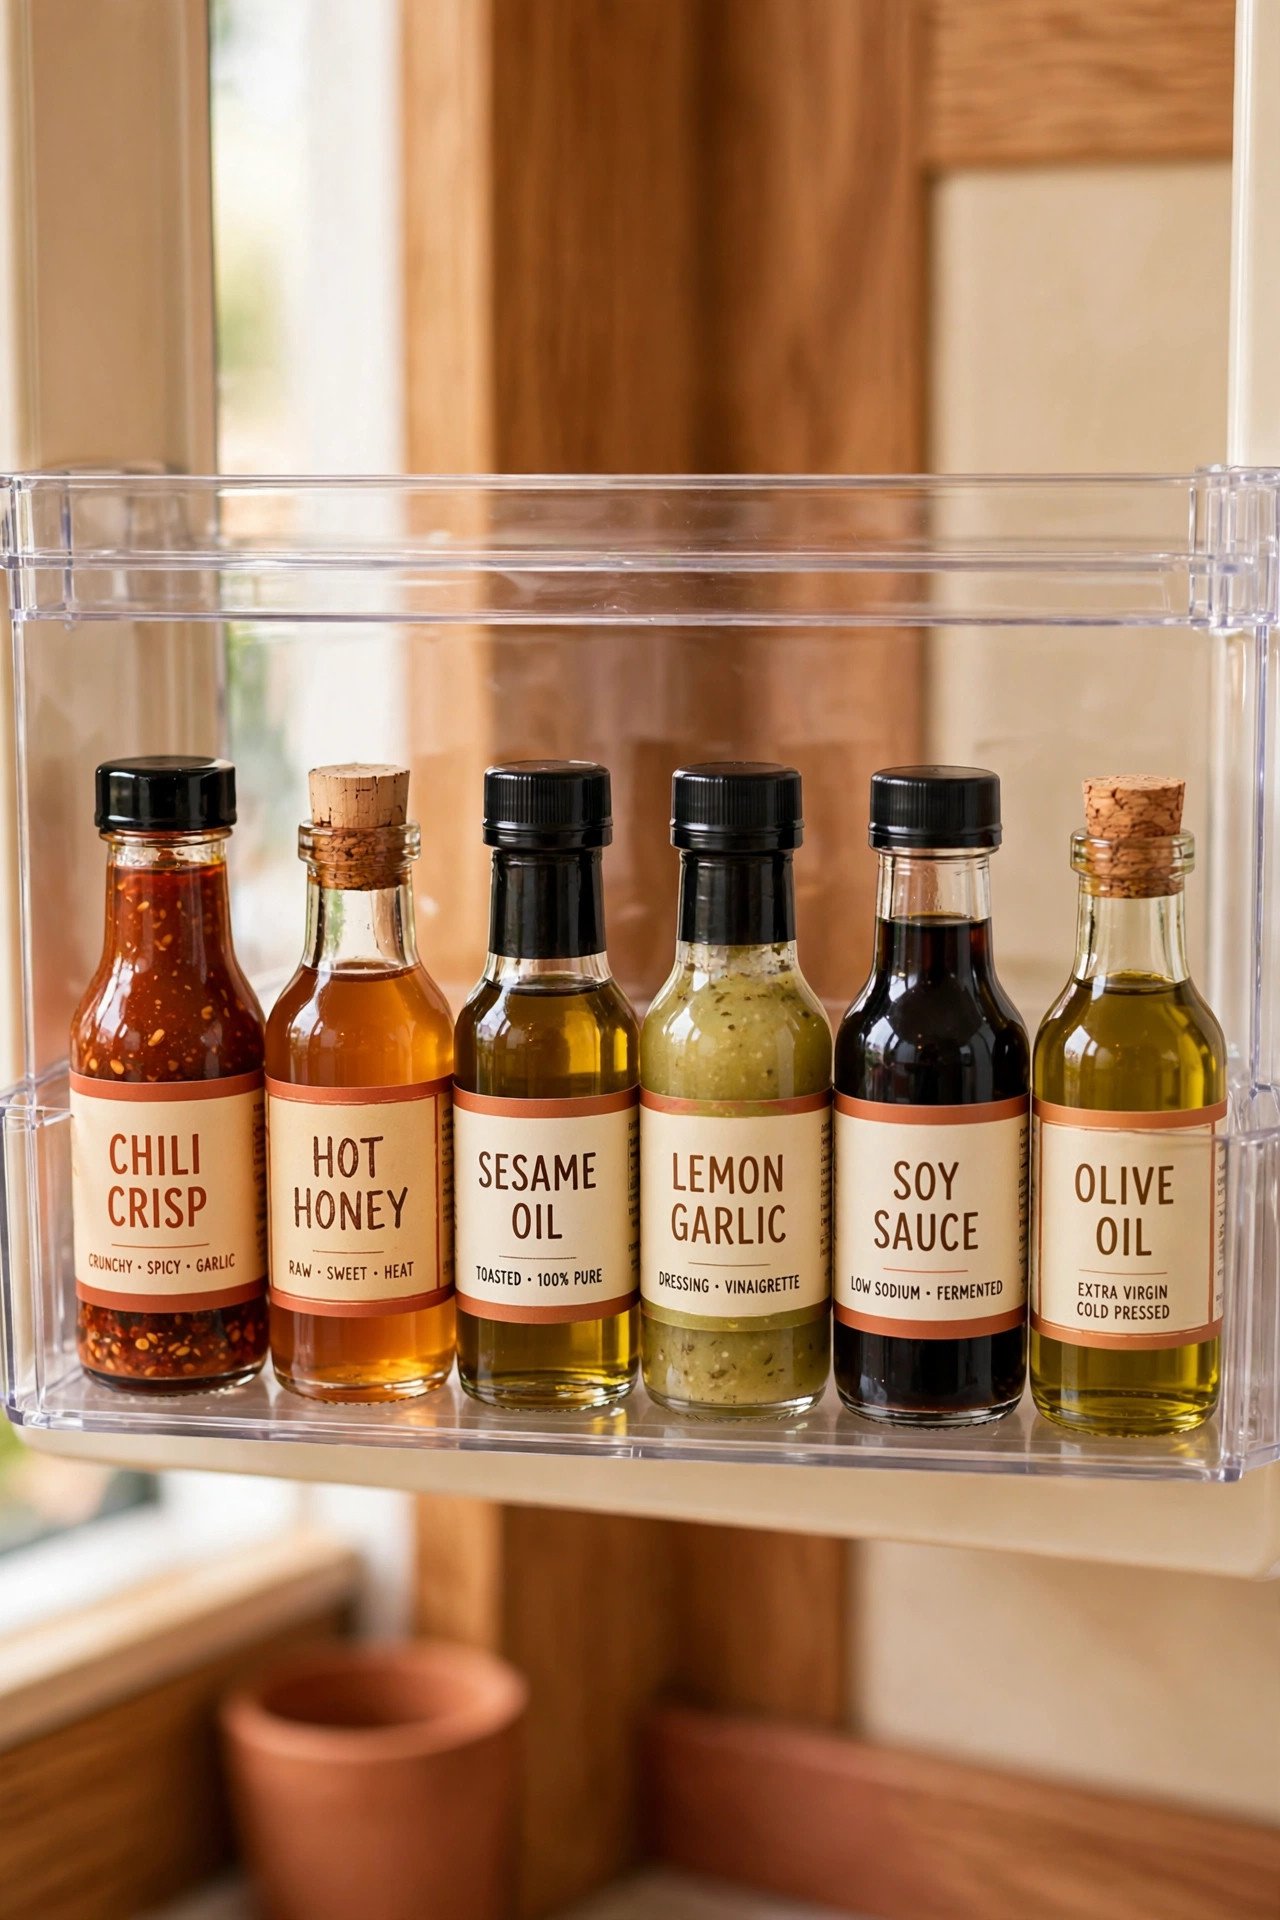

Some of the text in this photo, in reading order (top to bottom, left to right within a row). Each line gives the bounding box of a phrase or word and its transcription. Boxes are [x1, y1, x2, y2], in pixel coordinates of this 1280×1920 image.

[110, 1133, 200, 1176] CHILI
[314, 1136, 383, 1178] HOT
[479, 1152, 596, 1191] SESAME
[673, 1153, 783, 1194] LEMON
[894, 1161, 959, 1201] SOY
[1076, 1164, 1174, 1205] OLIVE
[109, 1186, 207, 1228] CRISP
[295, 1187, 408, 1230] HONEY
[512, 1203, 562, 1239] OIL
[672, 1203, 786, 1245] GARLIC
[874, 1210, 978, 1251] SAUCE
[1097, 1217, 1152, 1256] OIL
[88, 1253, 235, 1274] CRUNCHY SPICY GARLIC
[290, 1260, 414, 1280] RAW SWEET HEAT
[476, 1266, 602, 1286] TOASTED 100% PURE
[660, 1271, 799, 1294] DRESSING VINAIGRETTE
[851, 1276, 1002, 1300] LOW SODIUM FERMENTED
[1079, 1282, 1167, 1300] EXTRA VIRGIN
[1077, 1302, 1170, 1320] COLD PRESSED
